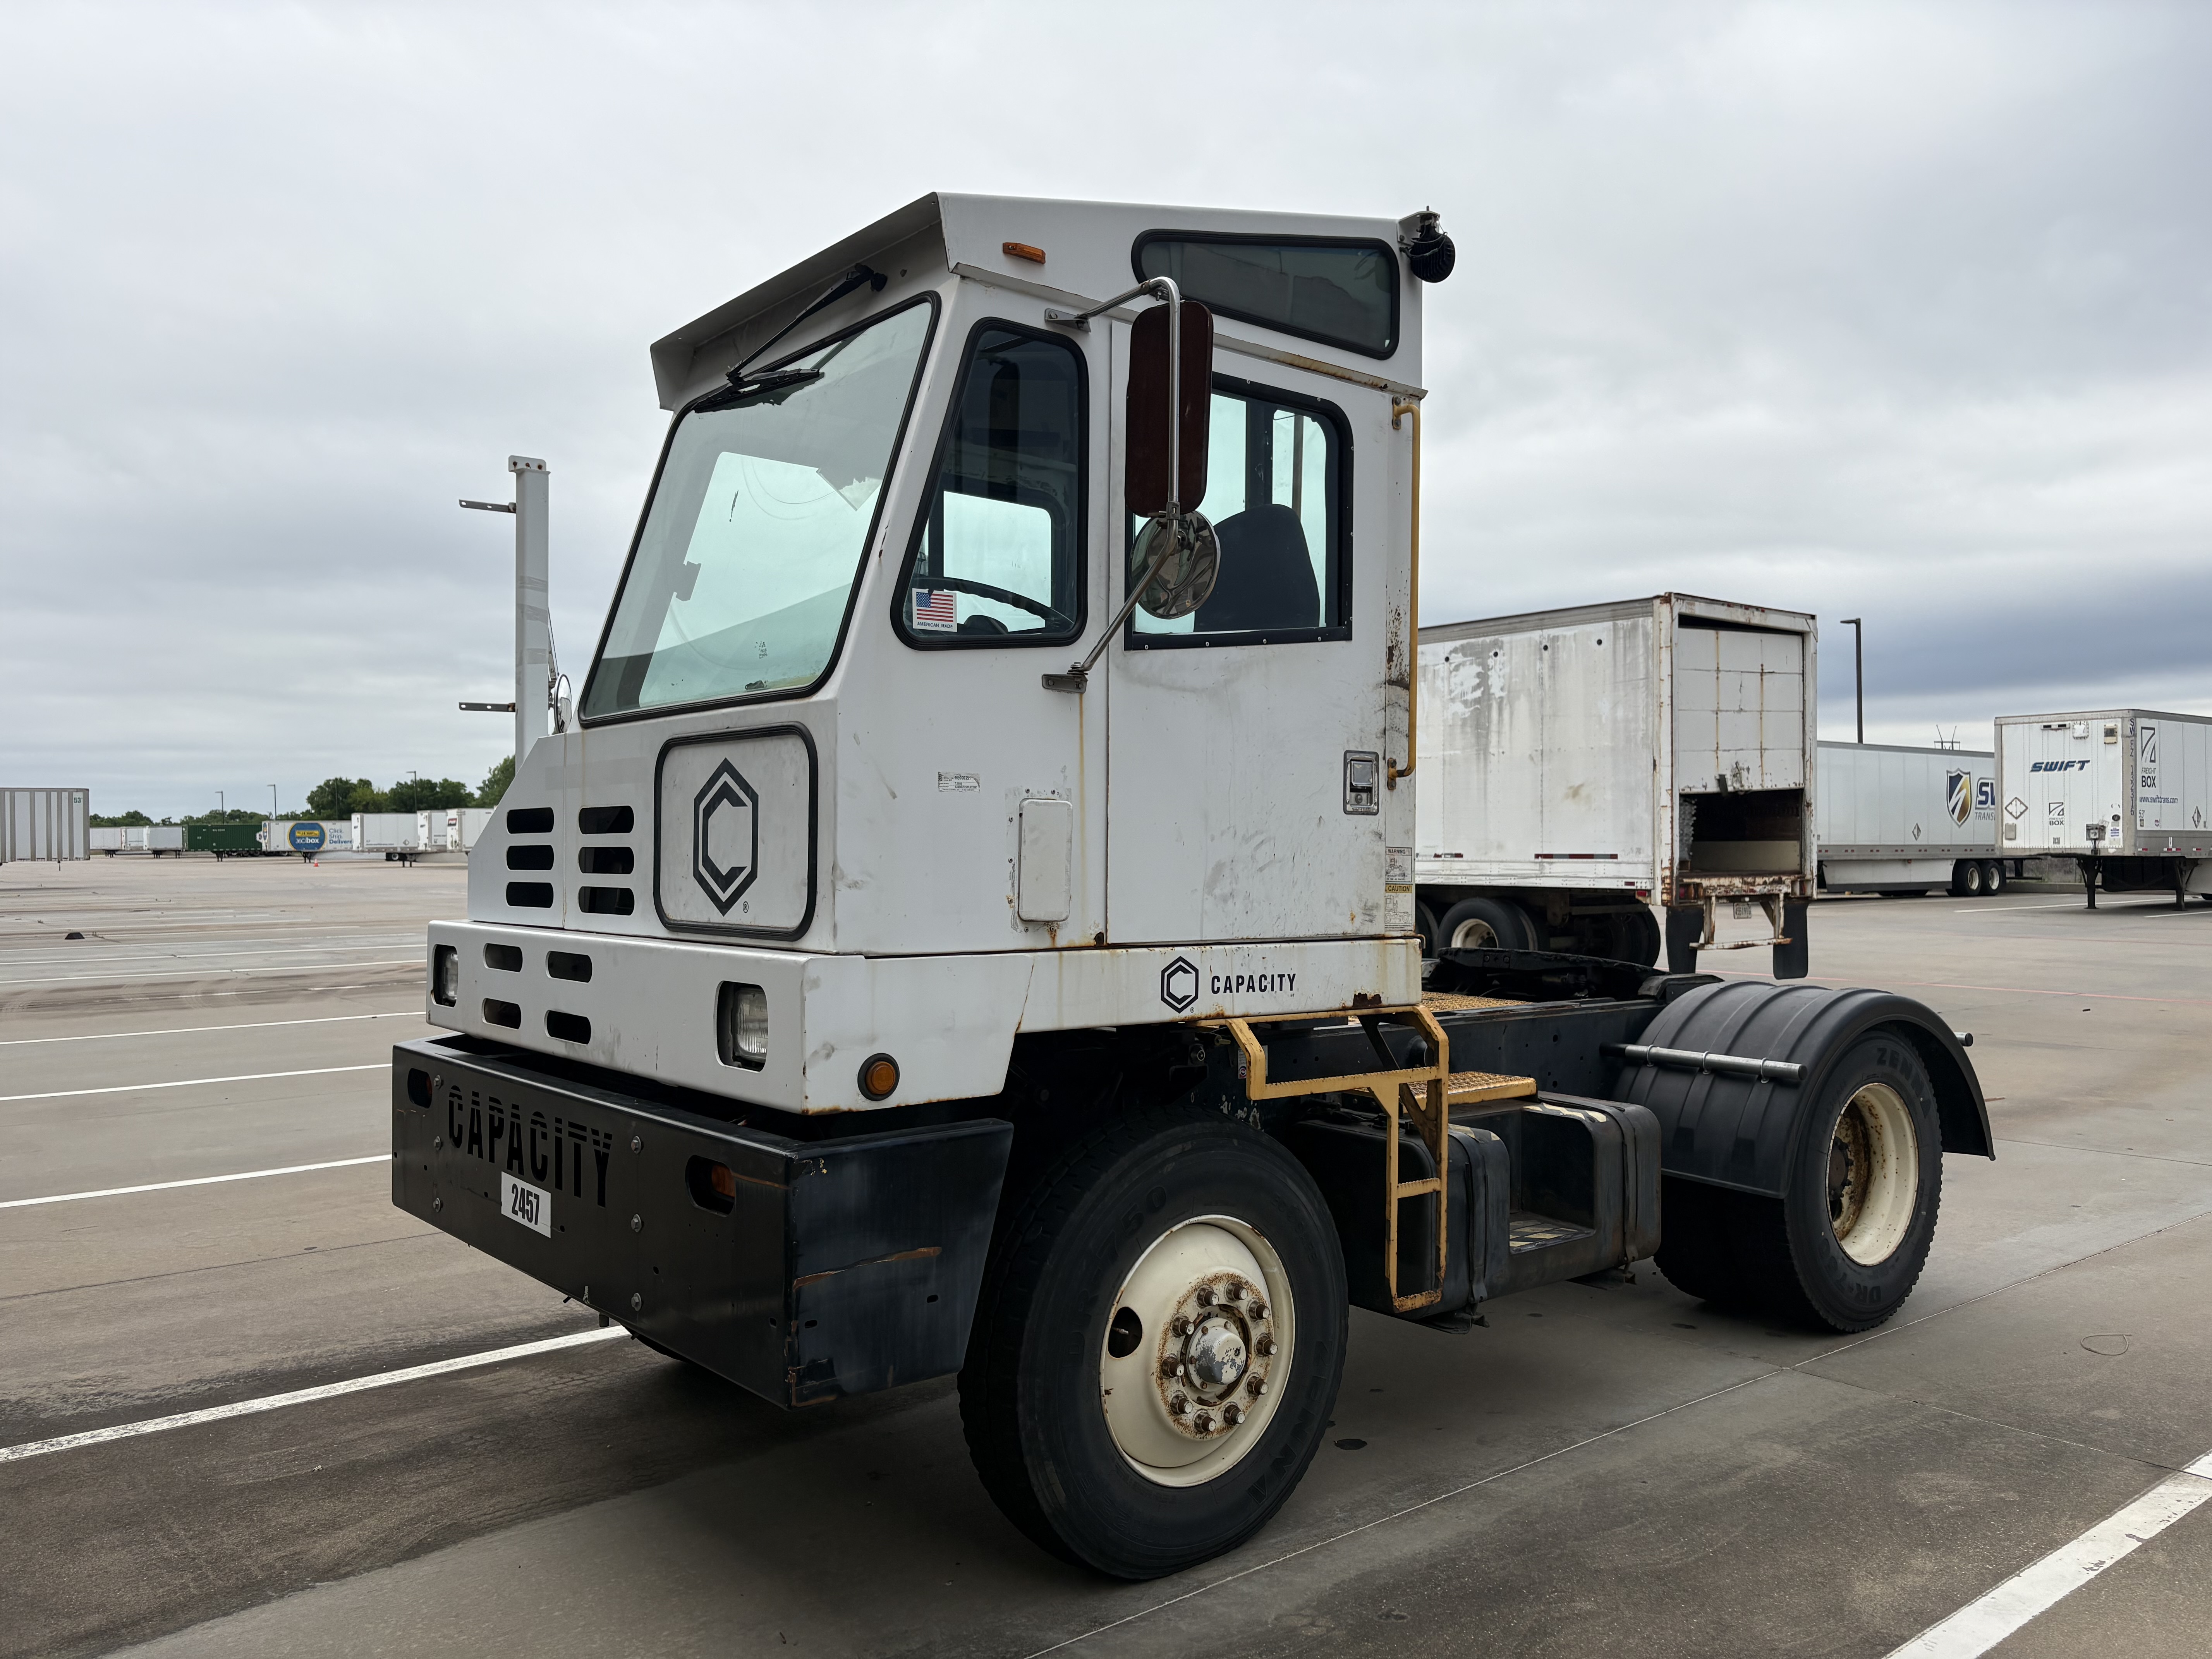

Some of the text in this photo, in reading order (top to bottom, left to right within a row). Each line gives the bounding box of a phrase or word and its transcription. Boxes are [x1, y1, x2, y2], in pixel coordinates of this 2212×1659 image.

[2029, 760, 2090, 773] SWIFT
[2142, 775, 2156, 788] BOX
[2139, 795, 2178, 804] www.swifttrans.com
[1975, 812, 1995, 821] TRANS
[1211, 973, 1296, 994] CAPACITY
[448, 1085, 613, 1208] CAPACITY
[511, 1183, 540, 1226] 2457
